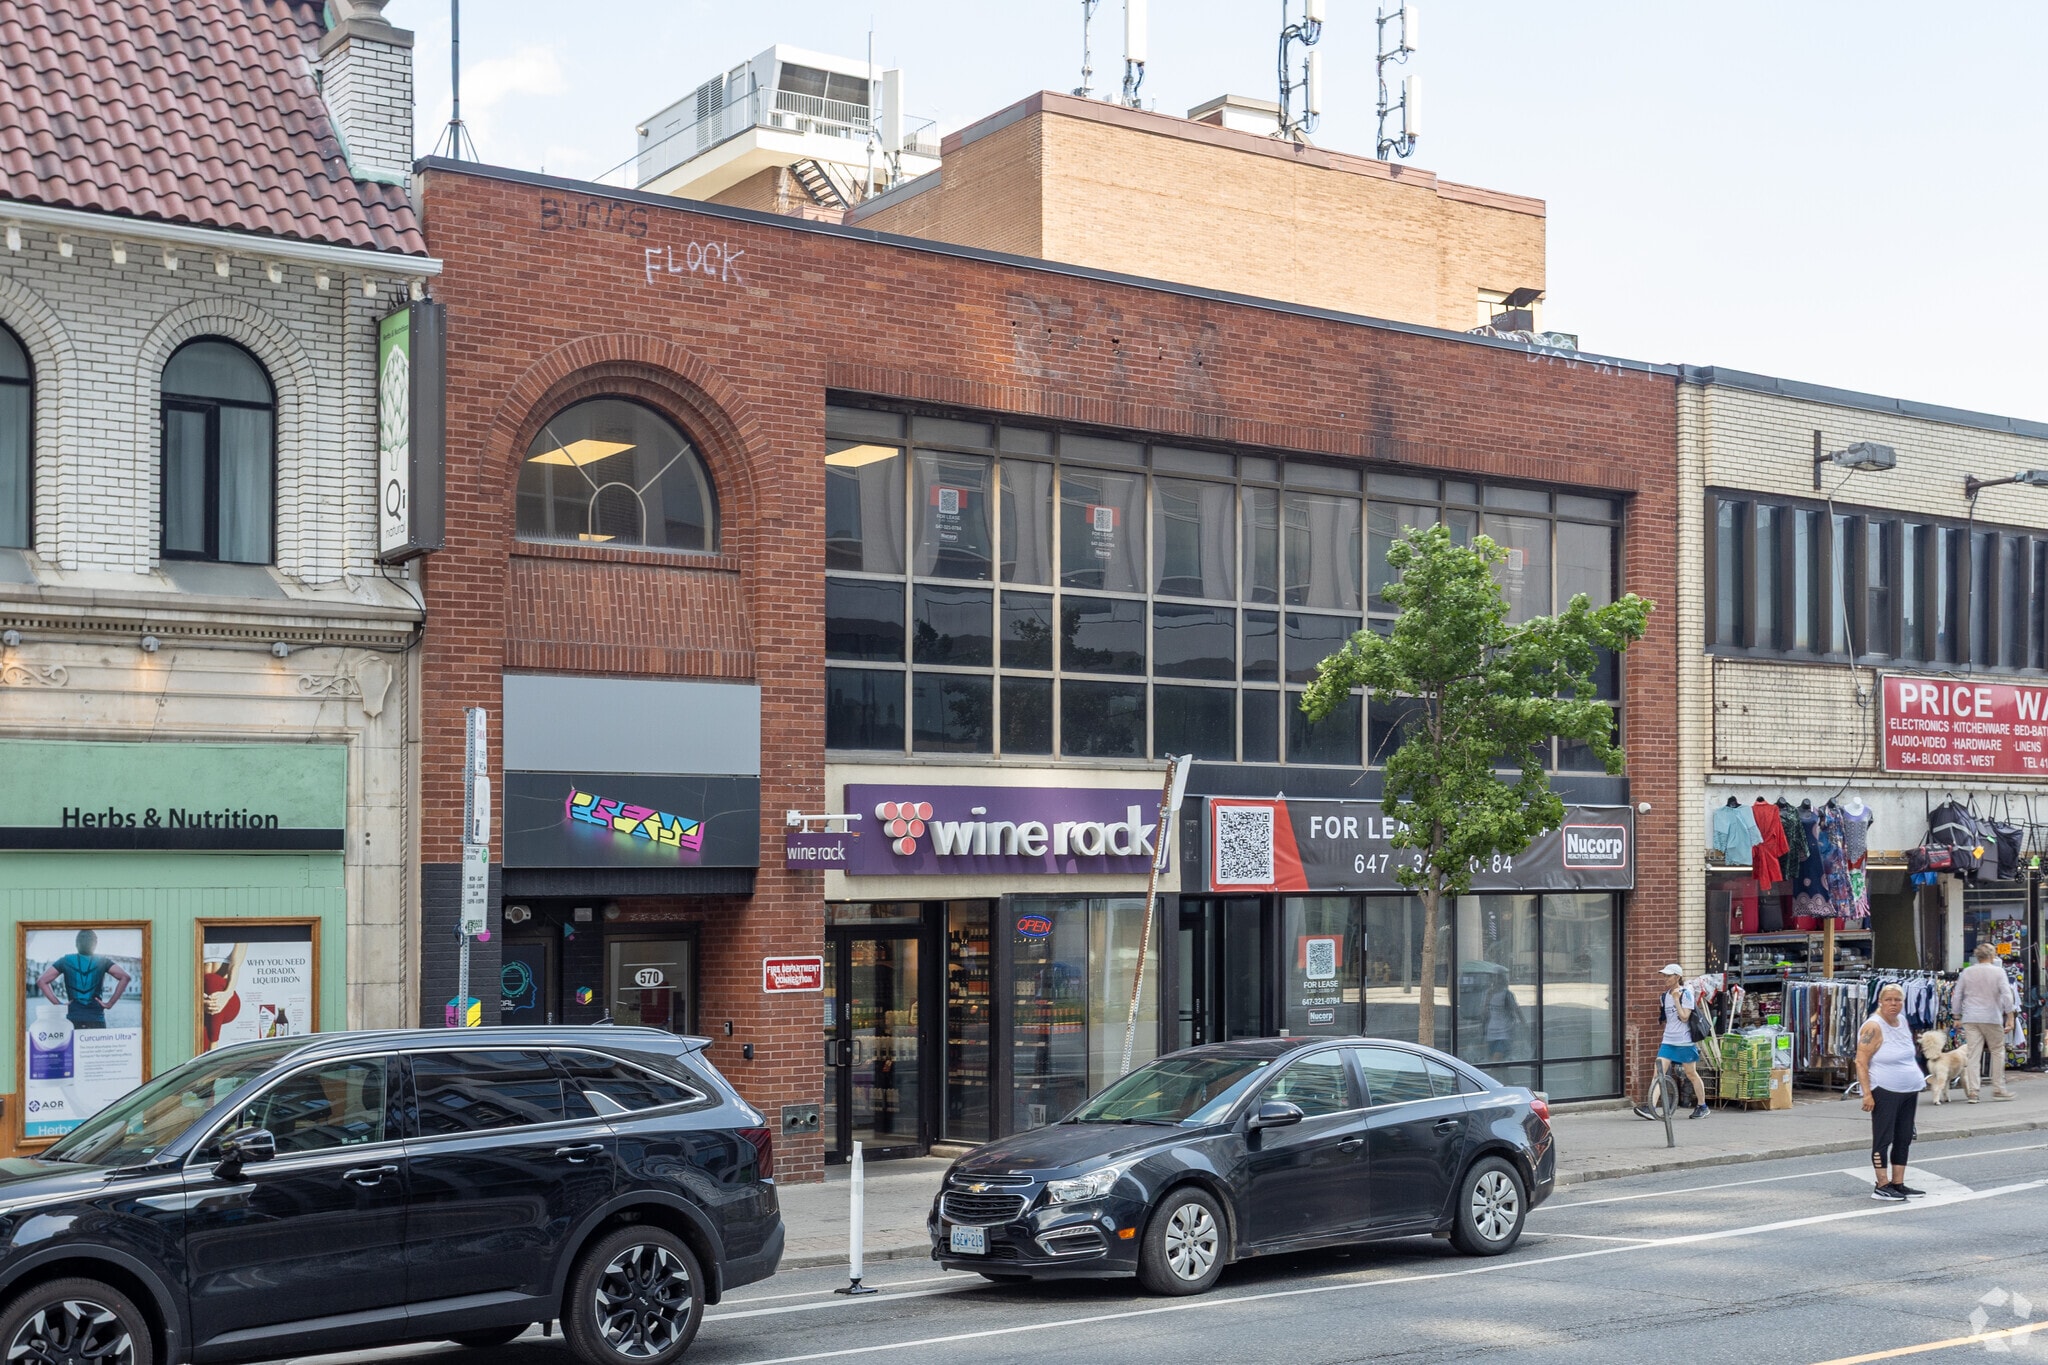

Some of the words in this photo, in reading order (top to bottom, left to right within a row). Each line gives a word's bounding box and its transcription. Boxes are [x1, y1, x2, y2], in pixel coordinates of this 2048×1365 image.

[645, 241, 745, 285] FLOCK
[386, 479, 405, 521] Qi
[1900, 682, 1993, 718] PRICE
[2015, 690, 2048, 722] W
[1889, 717, 1950, 733] ELECTRONICS
[1953, 721, 2010, 736] KITCHENWARE
[1891, 735, 1947, 749] AUDIO-VIDEO
[1954, 737, 2003, 751] HARDWARE
[2015, 741, 2042, 752] LINENS
[1901, 752, 1916, 764] 564
[1921, 753, 1952, 765] BLOOR
[1971, 755, 1996, 767] WEST
[2023, 756, 2038, 769] TEL
[62, 807, 137, 828] Herbs
[143, 808, 162, 828] &
[169, 808, 279, 829] Nutrition
[928, 806, 1048, 856] wine
[1053, 805, 1156, 856] rack
[1310, 816, 1359, 839] FOR
[1368, 817, 1410, 839] LEA
[787, 841, 816, 860] wine
[818, 840, 845, 860] rack
[1567, 834, 1622, 859] Nucorp
[1354, 854, 1389, 874] 647
[1469, 854, 1512, 873] 084
[1017, 918, 1052, 932] OPEN
[285, 958, 306, 966] NEED
[782, 963, 820, 973] DEPARTMENT
[257, 967, 296, 975] FLORADIX
[640, 971, 660, 984] 570
[252, 976, 280, 985] LIQUID
[1303, 981, 1318, 989] FOR
[1318, 980, 1339, 988] LEASE
[1310, 1011, 1333, 1021] Nucorp
[80, 1034, 114, 1042] Curcumin
[41, 1100, 64, 1109] AOR
[38, 1125, 73, 1135] Herbs
